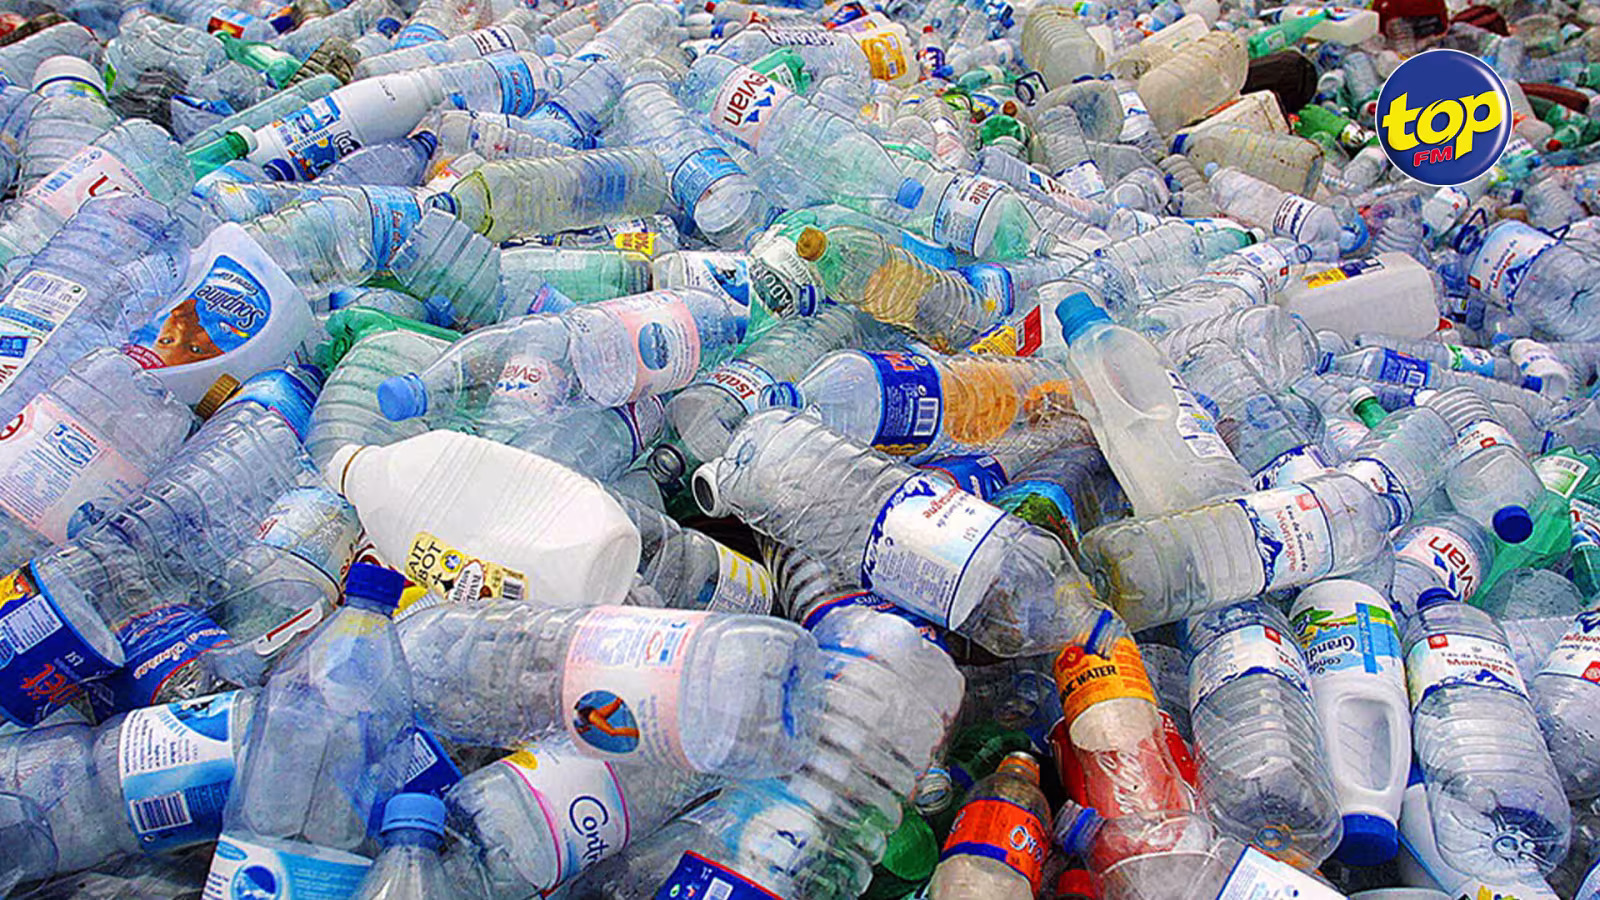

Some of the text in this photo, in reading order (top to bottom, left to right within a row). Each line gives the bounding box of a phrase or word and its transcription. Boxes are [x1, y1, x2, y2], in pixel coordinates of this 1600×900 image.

[724, 72, 767, 126] evian
[197, 284, 266, 329] Soupline
[503, 362, 546, 384] evia
[407, 541, 426, 573] AIT
[1275, 510, 1297, 572] Montagne
[1076, 665, 1117, 688] WATER
[1446, 657, 1515, 678] Montagne
